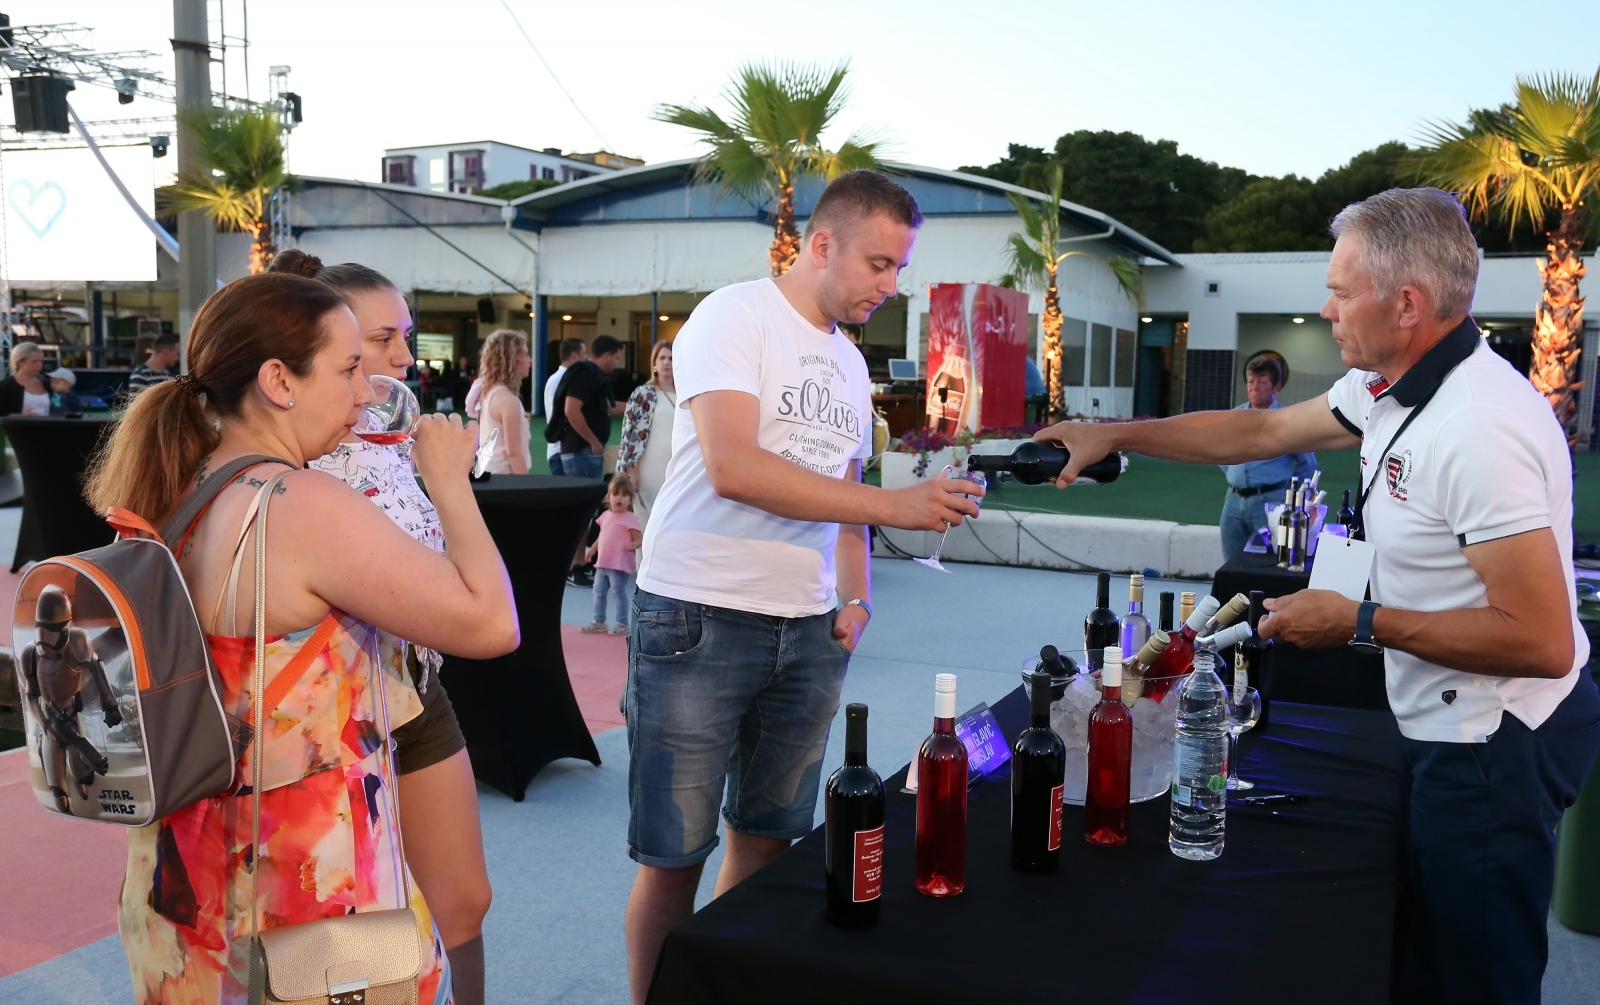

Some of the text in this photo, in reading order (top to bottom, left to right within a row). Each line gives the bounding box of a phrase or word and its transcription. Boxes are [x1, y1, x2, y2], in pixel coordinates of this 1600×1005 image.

[799, 354, 830, 367] ORIGINAL
[98, 789, 134, 800] STAR
[100, 803, 136, 815] WARS
